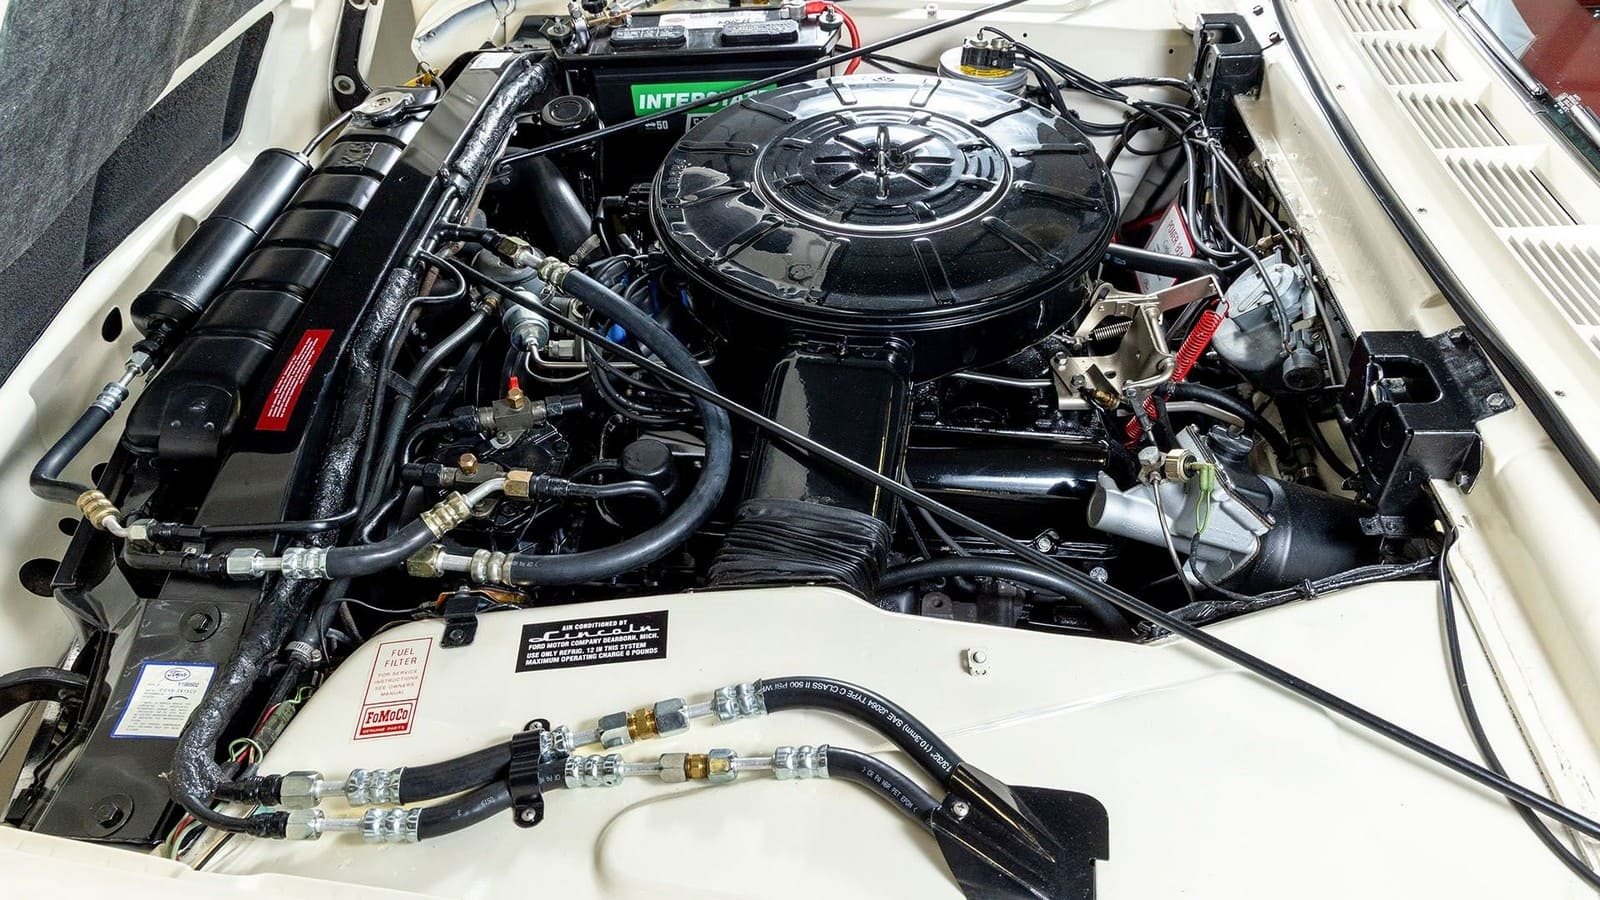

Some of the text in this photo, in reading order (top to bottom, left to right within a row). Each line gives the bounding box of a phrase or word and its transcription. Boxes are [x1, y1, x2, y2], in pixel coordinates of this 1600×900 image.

[574, 620, 618, 630] CONDITIONED
[528, 623, 660, 643] Lincoln
[528, 643, 546, 651] FORD
[546, 641, 570, 649] MOTOR
[570, 637, 602, 647] COMPANY
[639, 632, 660, 640] MICH.
[391, 648, 415, 657] FUEL
[540, 650, 559, 658] ONLY
[558, 647, 585, 656] REFRIG.
[619, 641, 647, 650] SYSTEM
[525, 657, 560, 666] MAXIMUM
[560, 653, 598, 662] OPERATING
[598, 650, 625, 659] CHARGE
[631, 647, 659, 656] POUNDS
[384, 657, 418, 668] FILTER
[392, 668, 418, 676] SERVICE
[374, 676, 418, 684] INSTRUCTIONS
[774, 681, 788, 690] PSI
[789, 681, 804, 689] 500
[380, 689, 404, 697] MANUAL
[812, 682, 839, 693] CLASS
[839, 687, 847, 695] C
[846, 689, 867, 705] TYPE
[867, 699, 889, 716] J2064
[366, 708, 408, 724] FoMoCo
[886, 712, 904, 728] SAE
